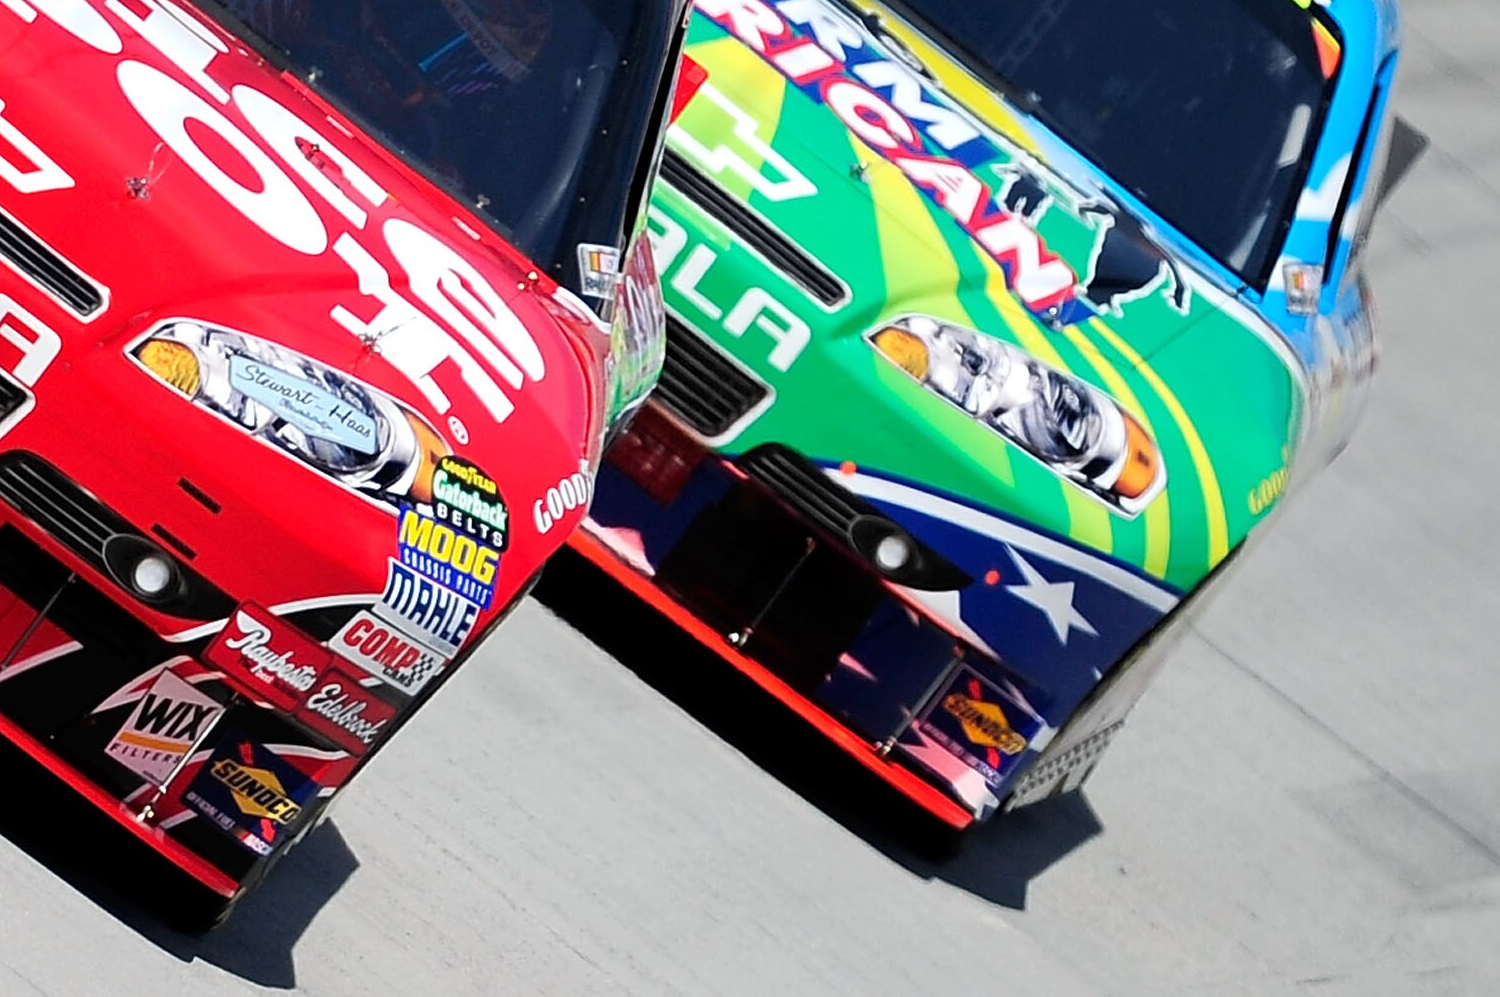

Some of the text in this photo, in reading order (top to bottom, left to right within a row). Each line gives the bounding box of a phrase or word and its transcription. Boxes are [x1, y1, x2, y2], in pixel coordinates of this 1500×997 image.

[236, 364, 316, 405] Stewart
[329, 403, 372, 440] Haas
[432, 468, 509, 532] Gatorback
[437, 502, 504, 548] BELTS
[399, 510, 500, 585] MOOG
[404, 547, 492, 605] CHASSIS PARTS
[381, 565, 479, 648] MAHLE
[225, 609, 318, 692] Raybestos
[342, 617, 421, 672] COMP
[382, 667, 413, 689] CAMS
[134, 694, 219, 742] WIX
[306, 683, 388, 744] Edelbrock
[109, 742, 183, 765] FILTERS
[214, 761, 299, 823] SUNOCO
